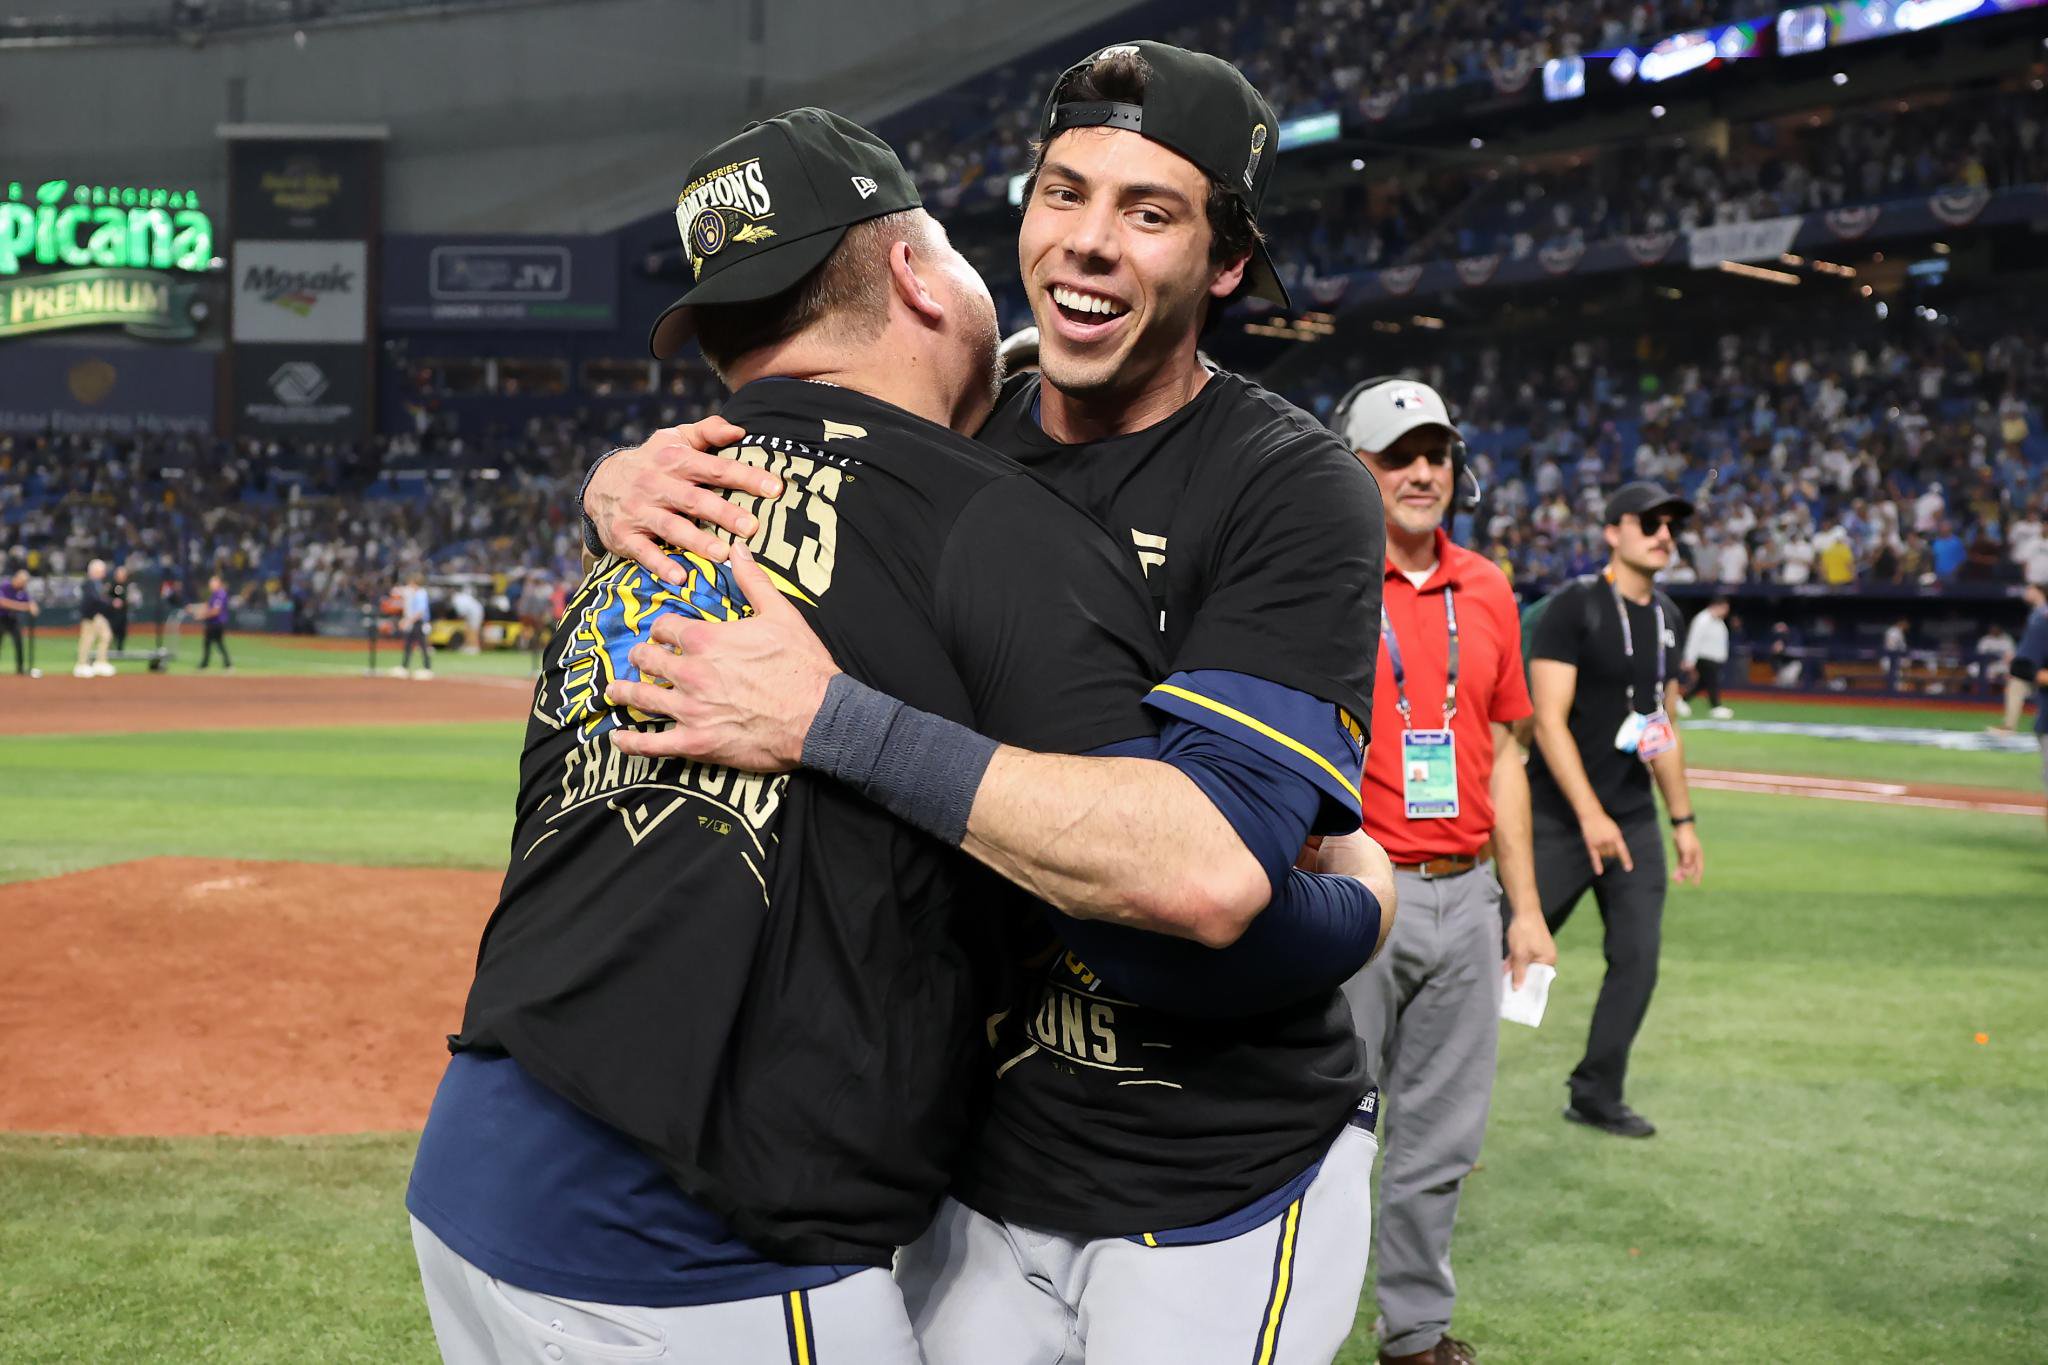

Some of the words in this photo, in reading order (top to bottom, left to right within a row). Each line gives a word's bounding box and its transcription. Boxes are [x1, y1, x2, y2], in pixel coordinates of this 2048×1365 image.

[684, 177, 706, 195] WORLD
[707, 163, 739, 181] SERIES
[243, 264, 355, 292] Mosaic
[10, 279, 170, 323] PREMIUM
